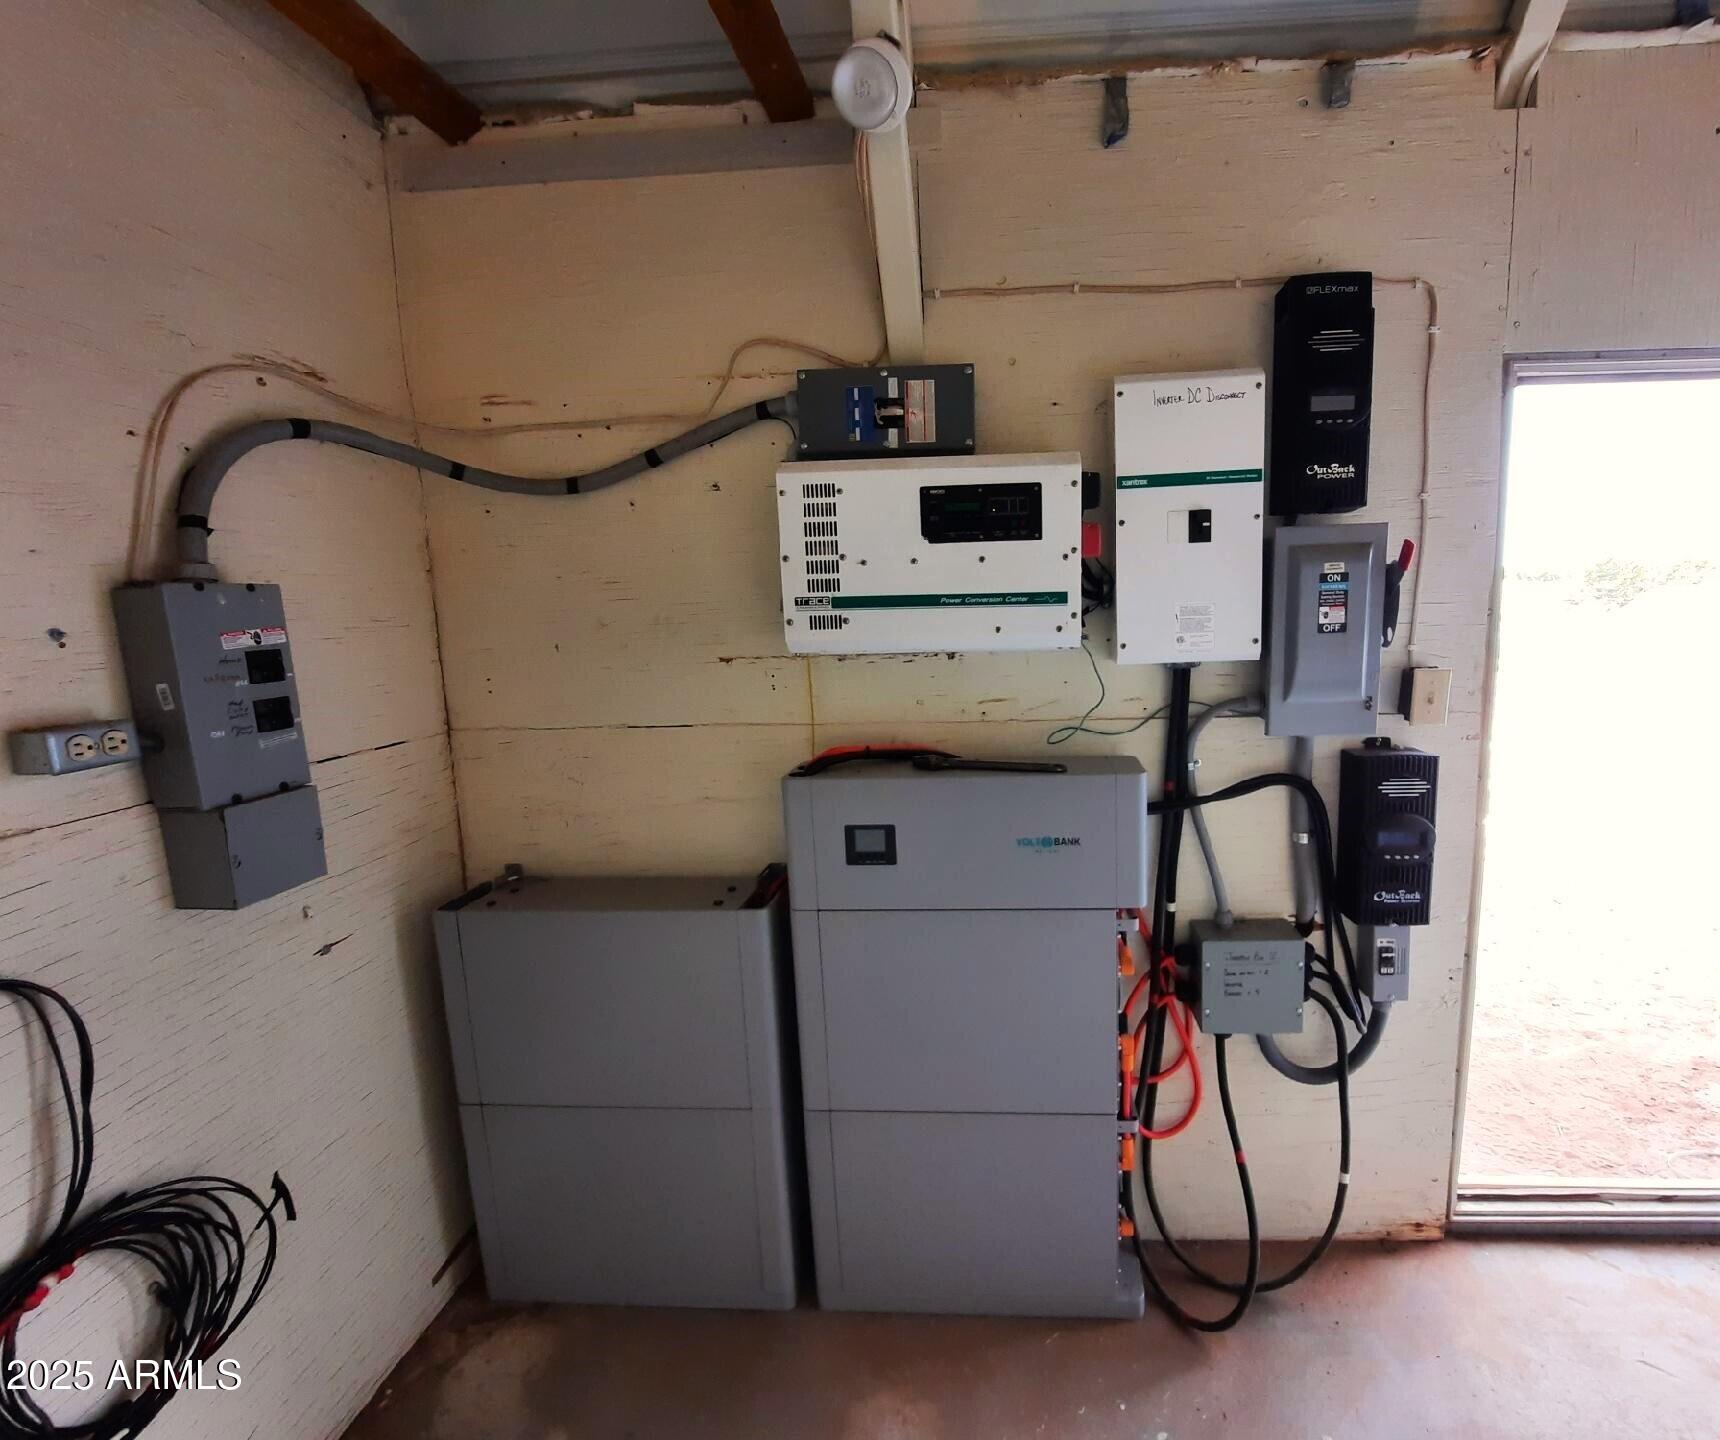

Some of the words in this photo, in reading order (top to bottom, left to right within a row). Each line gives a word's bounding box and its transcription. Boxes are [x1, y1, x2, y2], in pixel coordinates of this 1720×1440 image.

[1187, 386, 1202, 404] DC
[1327, 573, 1341, 582] ON
[964, 596, 1003, 604] Conversion
[1322, 623, 1341, 633] OFF
[1054, 837, 1080, 846] BANK
